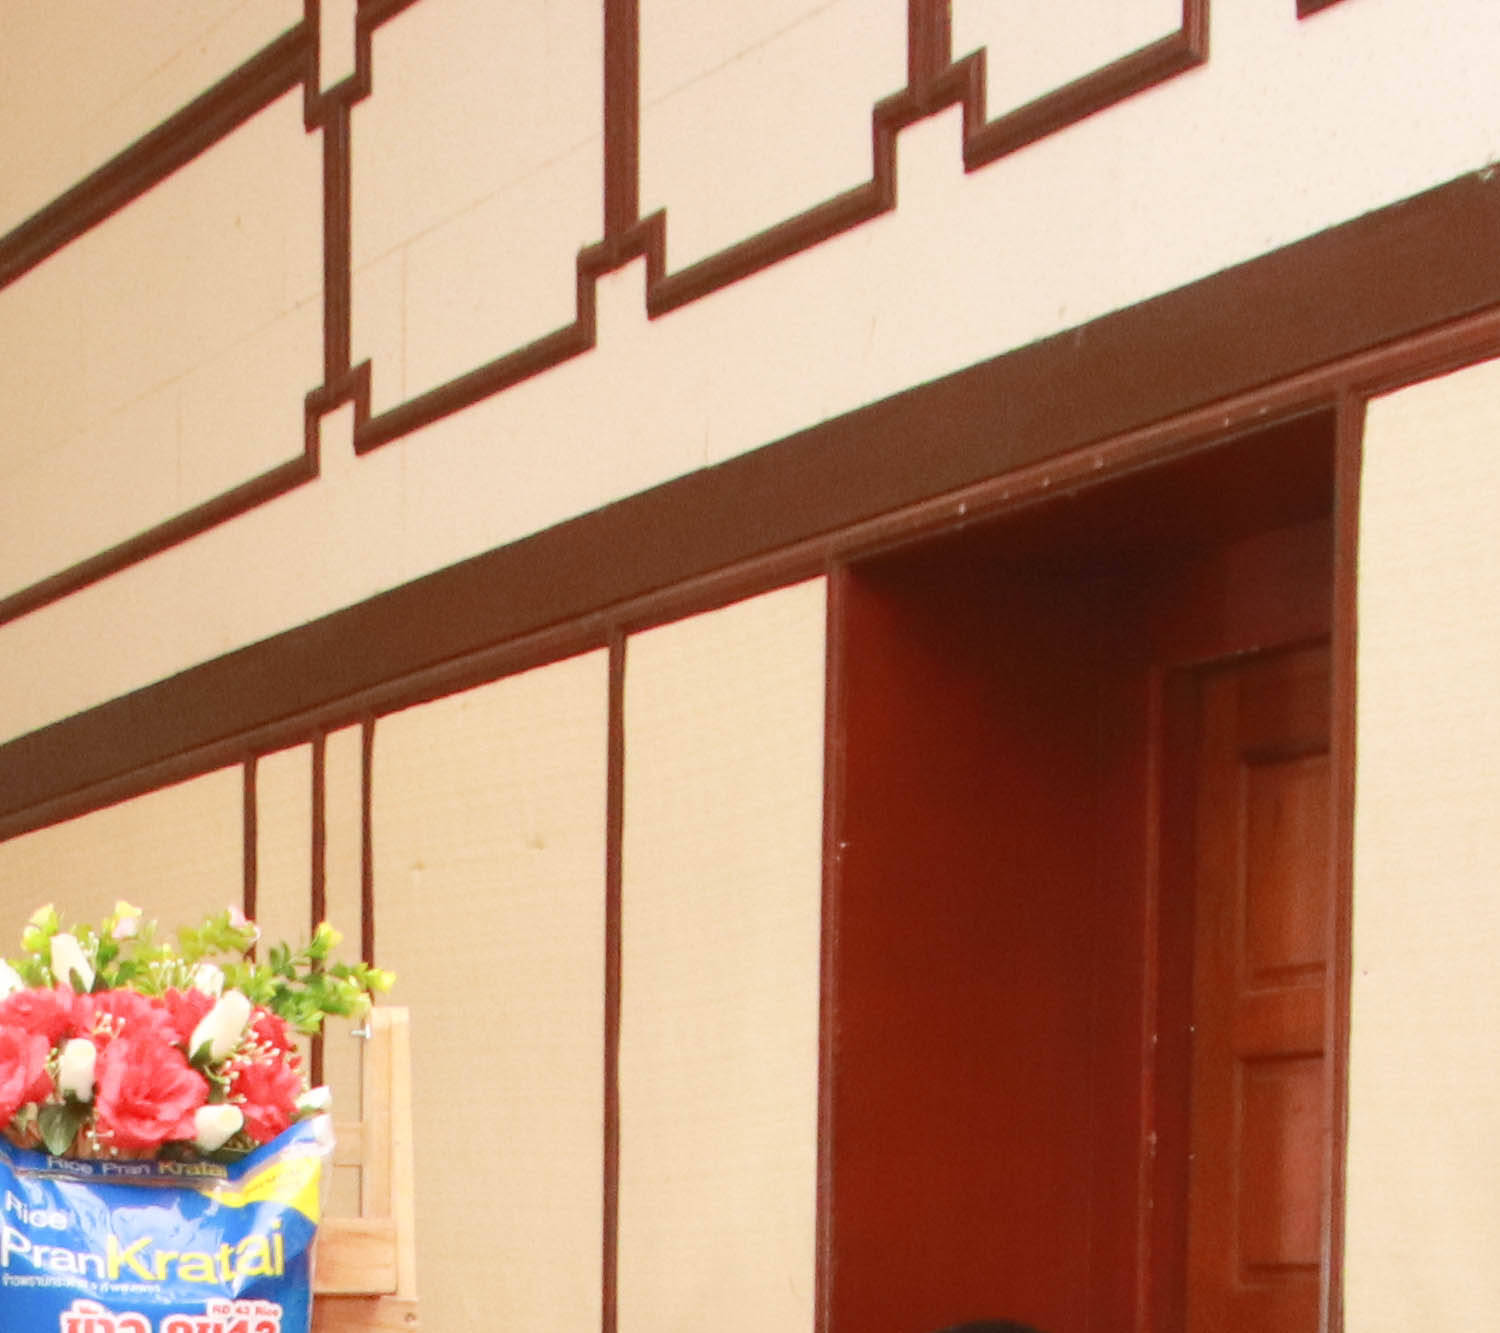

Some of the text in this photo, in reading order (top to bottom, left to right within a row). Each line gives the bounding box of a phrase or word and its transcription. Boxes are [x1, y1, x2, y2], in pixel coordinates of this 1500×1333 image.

[49, 1157, 93, 1175] Rice
[102, 1162, 150, 1176] Pran
[5, 1190, 68, 1230] Rice
